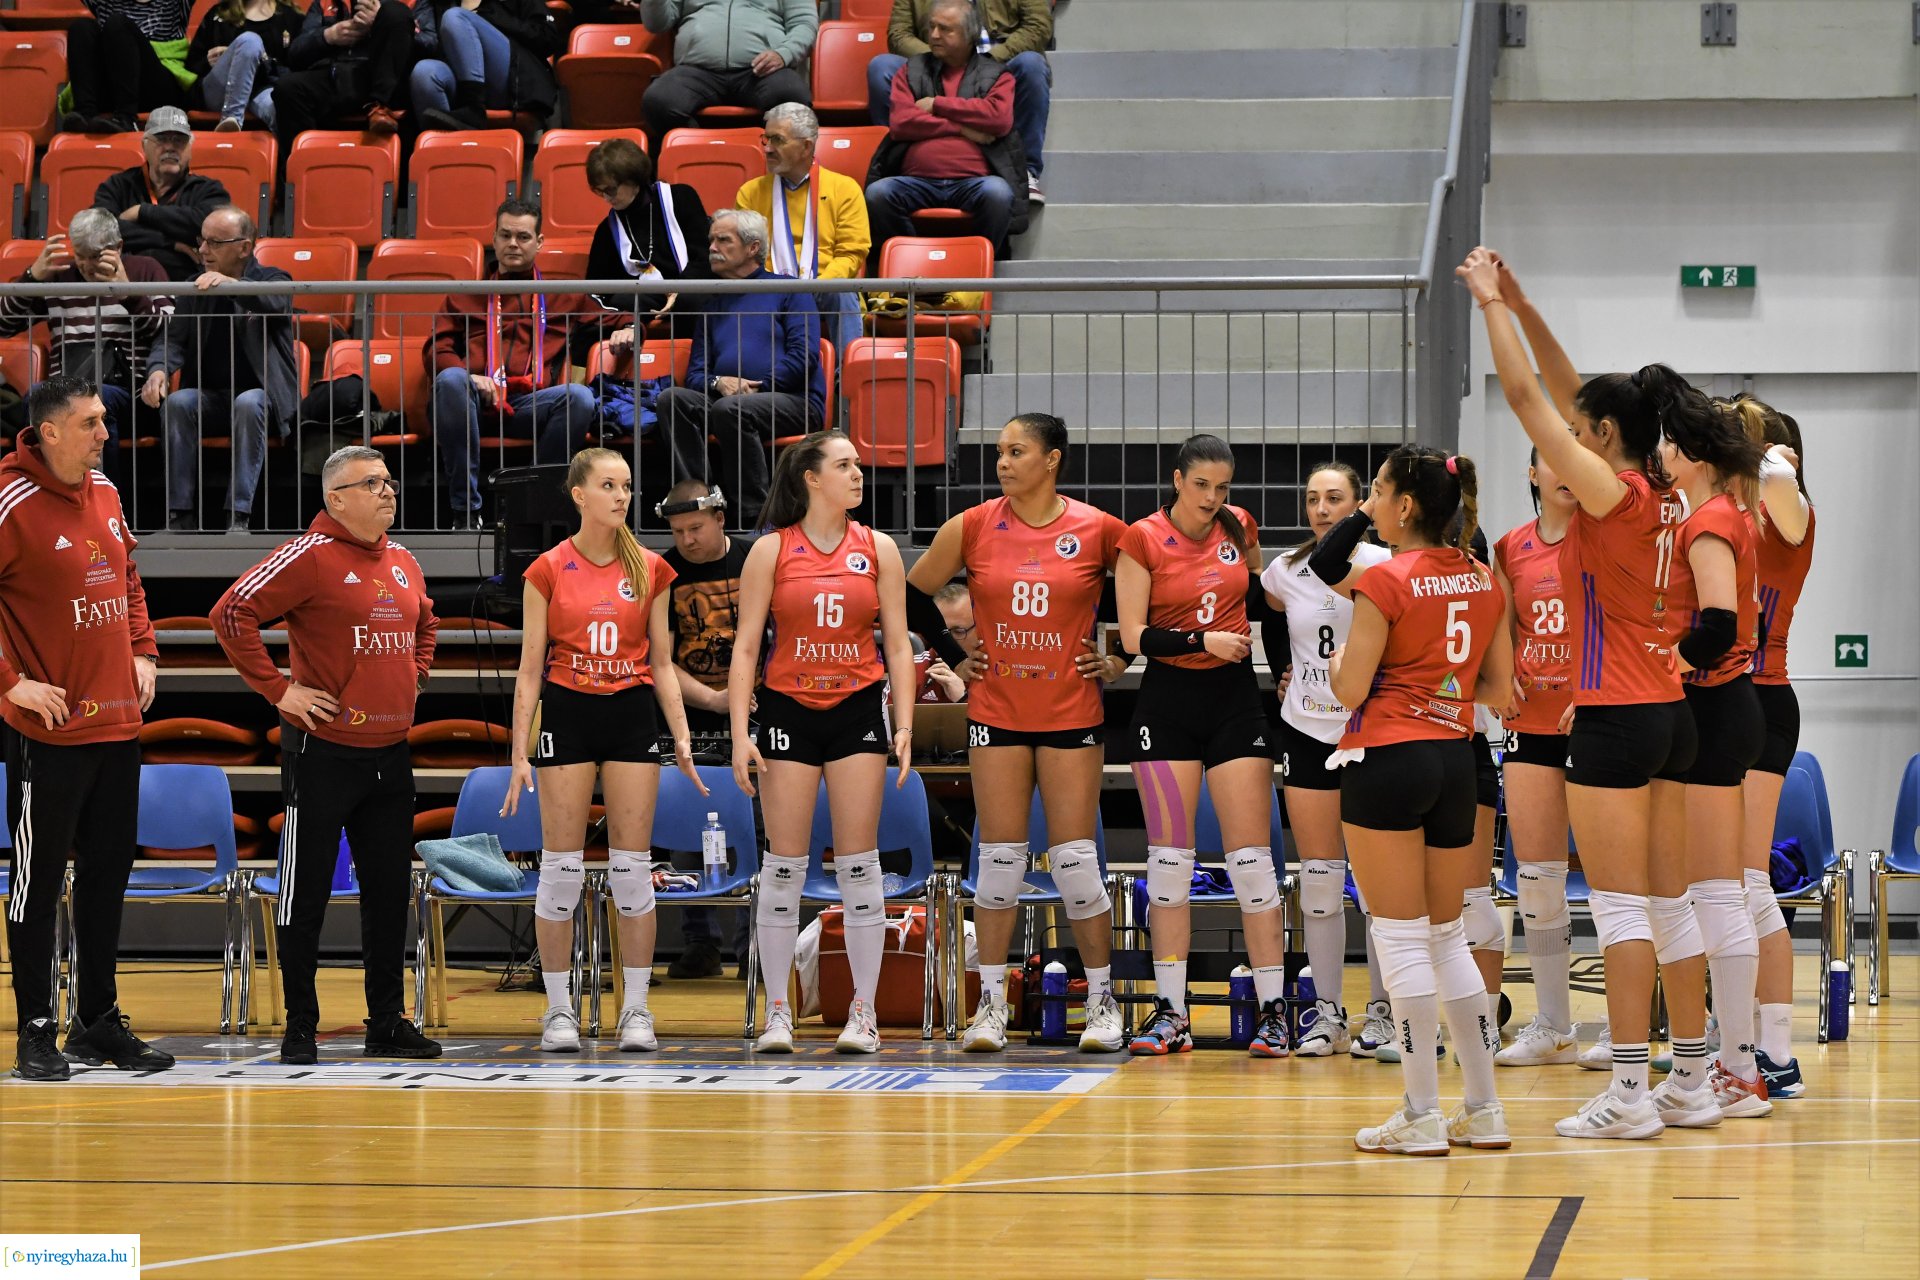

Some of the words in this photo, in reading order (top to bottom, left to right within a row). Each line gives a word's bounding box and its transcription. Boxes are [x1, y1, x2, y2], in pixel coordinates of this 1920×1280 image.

[1655, 529, 1673, 589] 11
[70, 595, 128, 624] FATUM
[813, 593, 844, 628] 15
[1011, 581, 1049, 617] 88
[1197, 591, 1217, 624] 3
[1531, 598, 1564, 634] 23
[351, 624, 415, 649] FATUM
[586, 621, 618, 656] 10
[995, 622, 1063, 646] FATUM
[1318, 625, 1335, 659] 8
[1446, 600, 1471, 663] 5
[795, 636, 860, 658] FATUM
[995, 642, 1062, 652] PROPERTY
[571, 653, 638, 675] FATUM
[1317, 703, 1344, 713] Többet
[1430, 701, 1458, 716] STRABAG
[768, 727, 790, 751] 15
[969, 725, 990, 747] 88
[1140, 726, 1151, 751] 3
[1401, 1019, 1413, 1053] MIKASA
[1478, 1015, 1490, 1050] MIKASA
